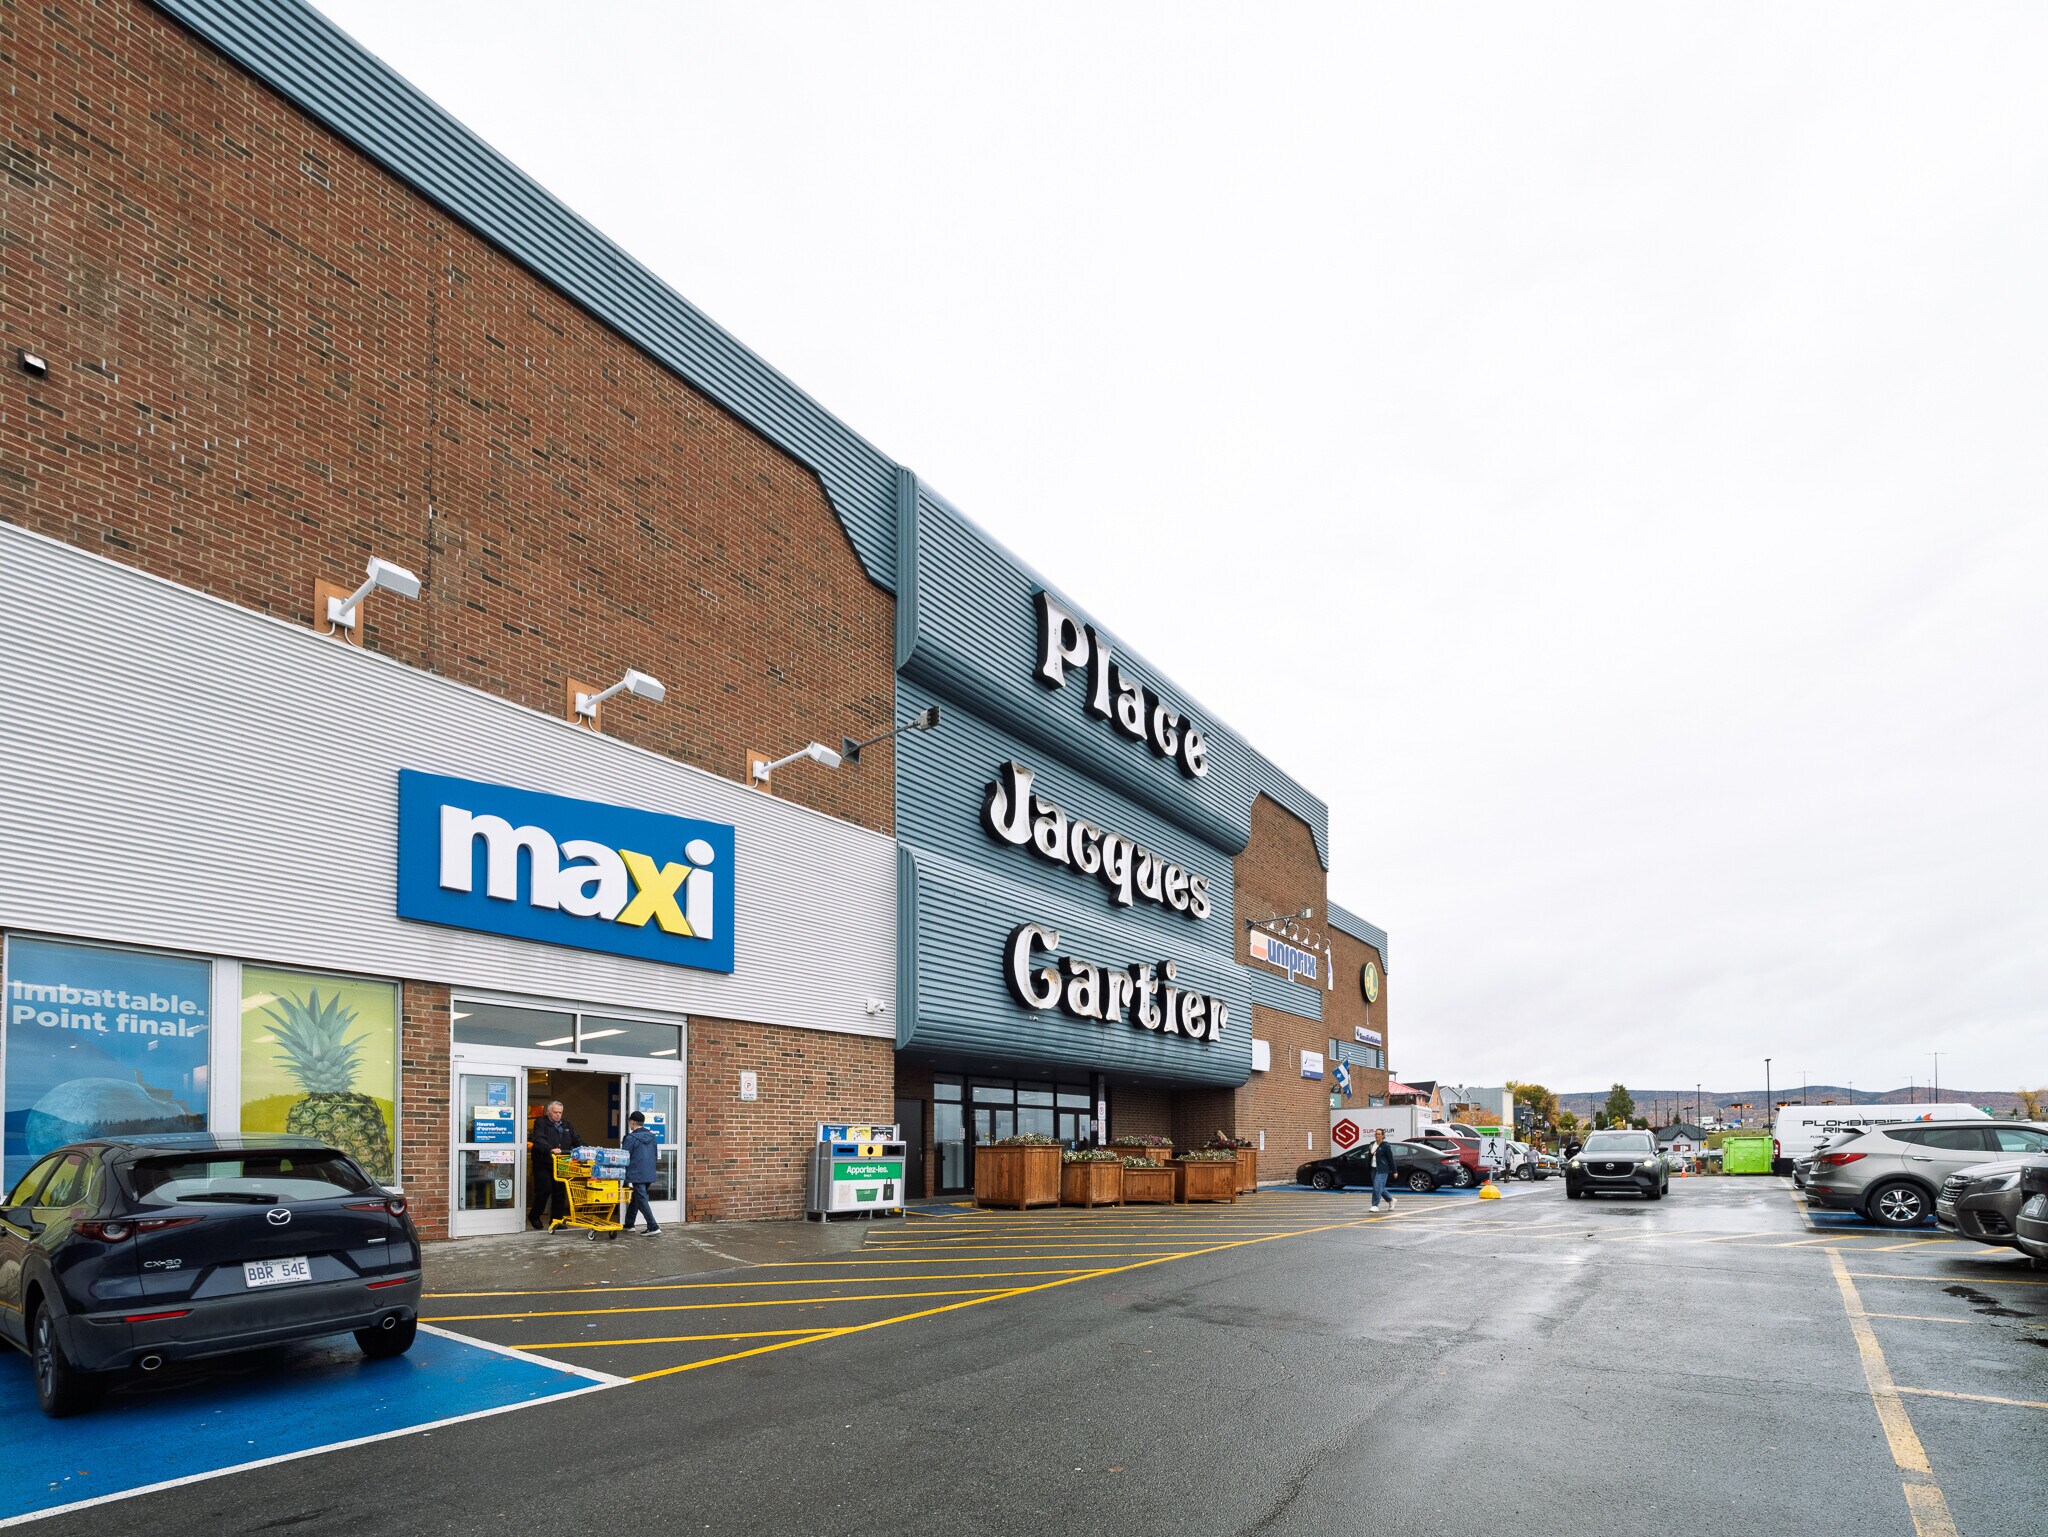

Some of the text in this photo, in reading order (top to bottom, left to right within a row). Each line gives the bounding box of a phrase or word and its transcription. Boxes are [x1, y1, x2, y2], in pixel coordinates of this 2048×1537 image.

[1036, 591, 1209, 778] Place
[982, 761, 1211, 919] Jacques
[440, 804, 715, 940] maxi
[1267, 938, 1316, 981] uniprix
[13, 980, 205, 1016] Imbattable.
[1007, 922, 1228, 1042] Cartier
[12, 1005, 195, 1038] Point final.
[846, 1165, 888, 1176] Apportez-les.
[143, 1258, 182, 1268] CX-30
[247, 1262, 307, 1281] BBR 54E
